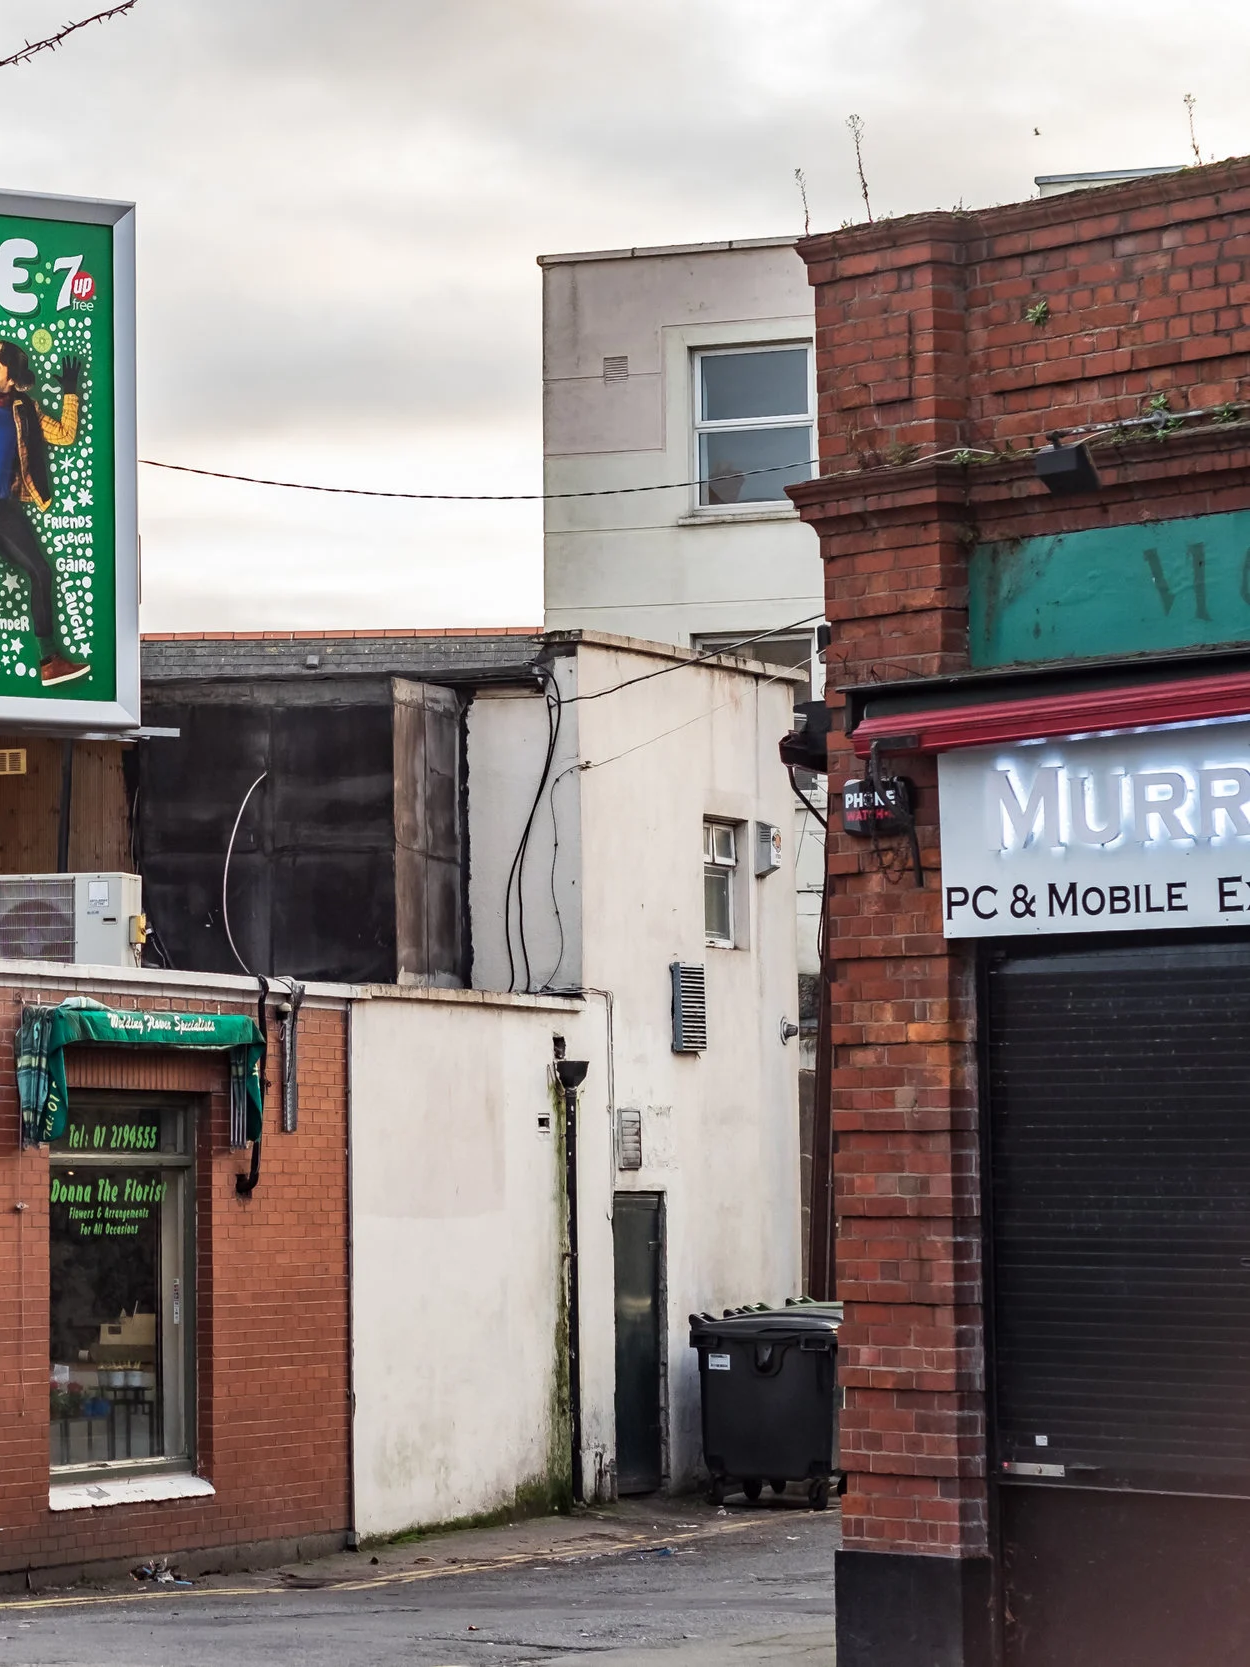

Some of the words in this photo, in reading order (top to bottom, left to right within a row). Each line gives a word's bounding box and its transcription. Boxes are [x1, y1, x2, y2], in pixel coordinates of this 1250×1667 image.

[72, 298, 94, 311] free
[945, 884, 999, 920] PC
[1010, 883, 1037, 918] &
[1047, 881, 1189, 917] MOBILE
[1217, 875, 1250, 913] E
[174, 1015, 216, 1035] Specialists
[69, 1124, 89, 1148] Tel:
[93, 1124, 106, 1148] 01
[110, 1124, 157, 1149] 2194555
[50, 1178, 92, 1203] Donna
[97, 1178, 118, 1202] The
[124, 1178, 168, 1202] Florist
[69, 1206, 95, 1219] Flowers
[96, 1206, 102, 1219] &
[104, 1206, 149, 1222] Arrangements
[80, 1222, 91, 1235] For
[93, 1222, 103, 1235] All
[105, 1222, 138, 1235] Occasions
